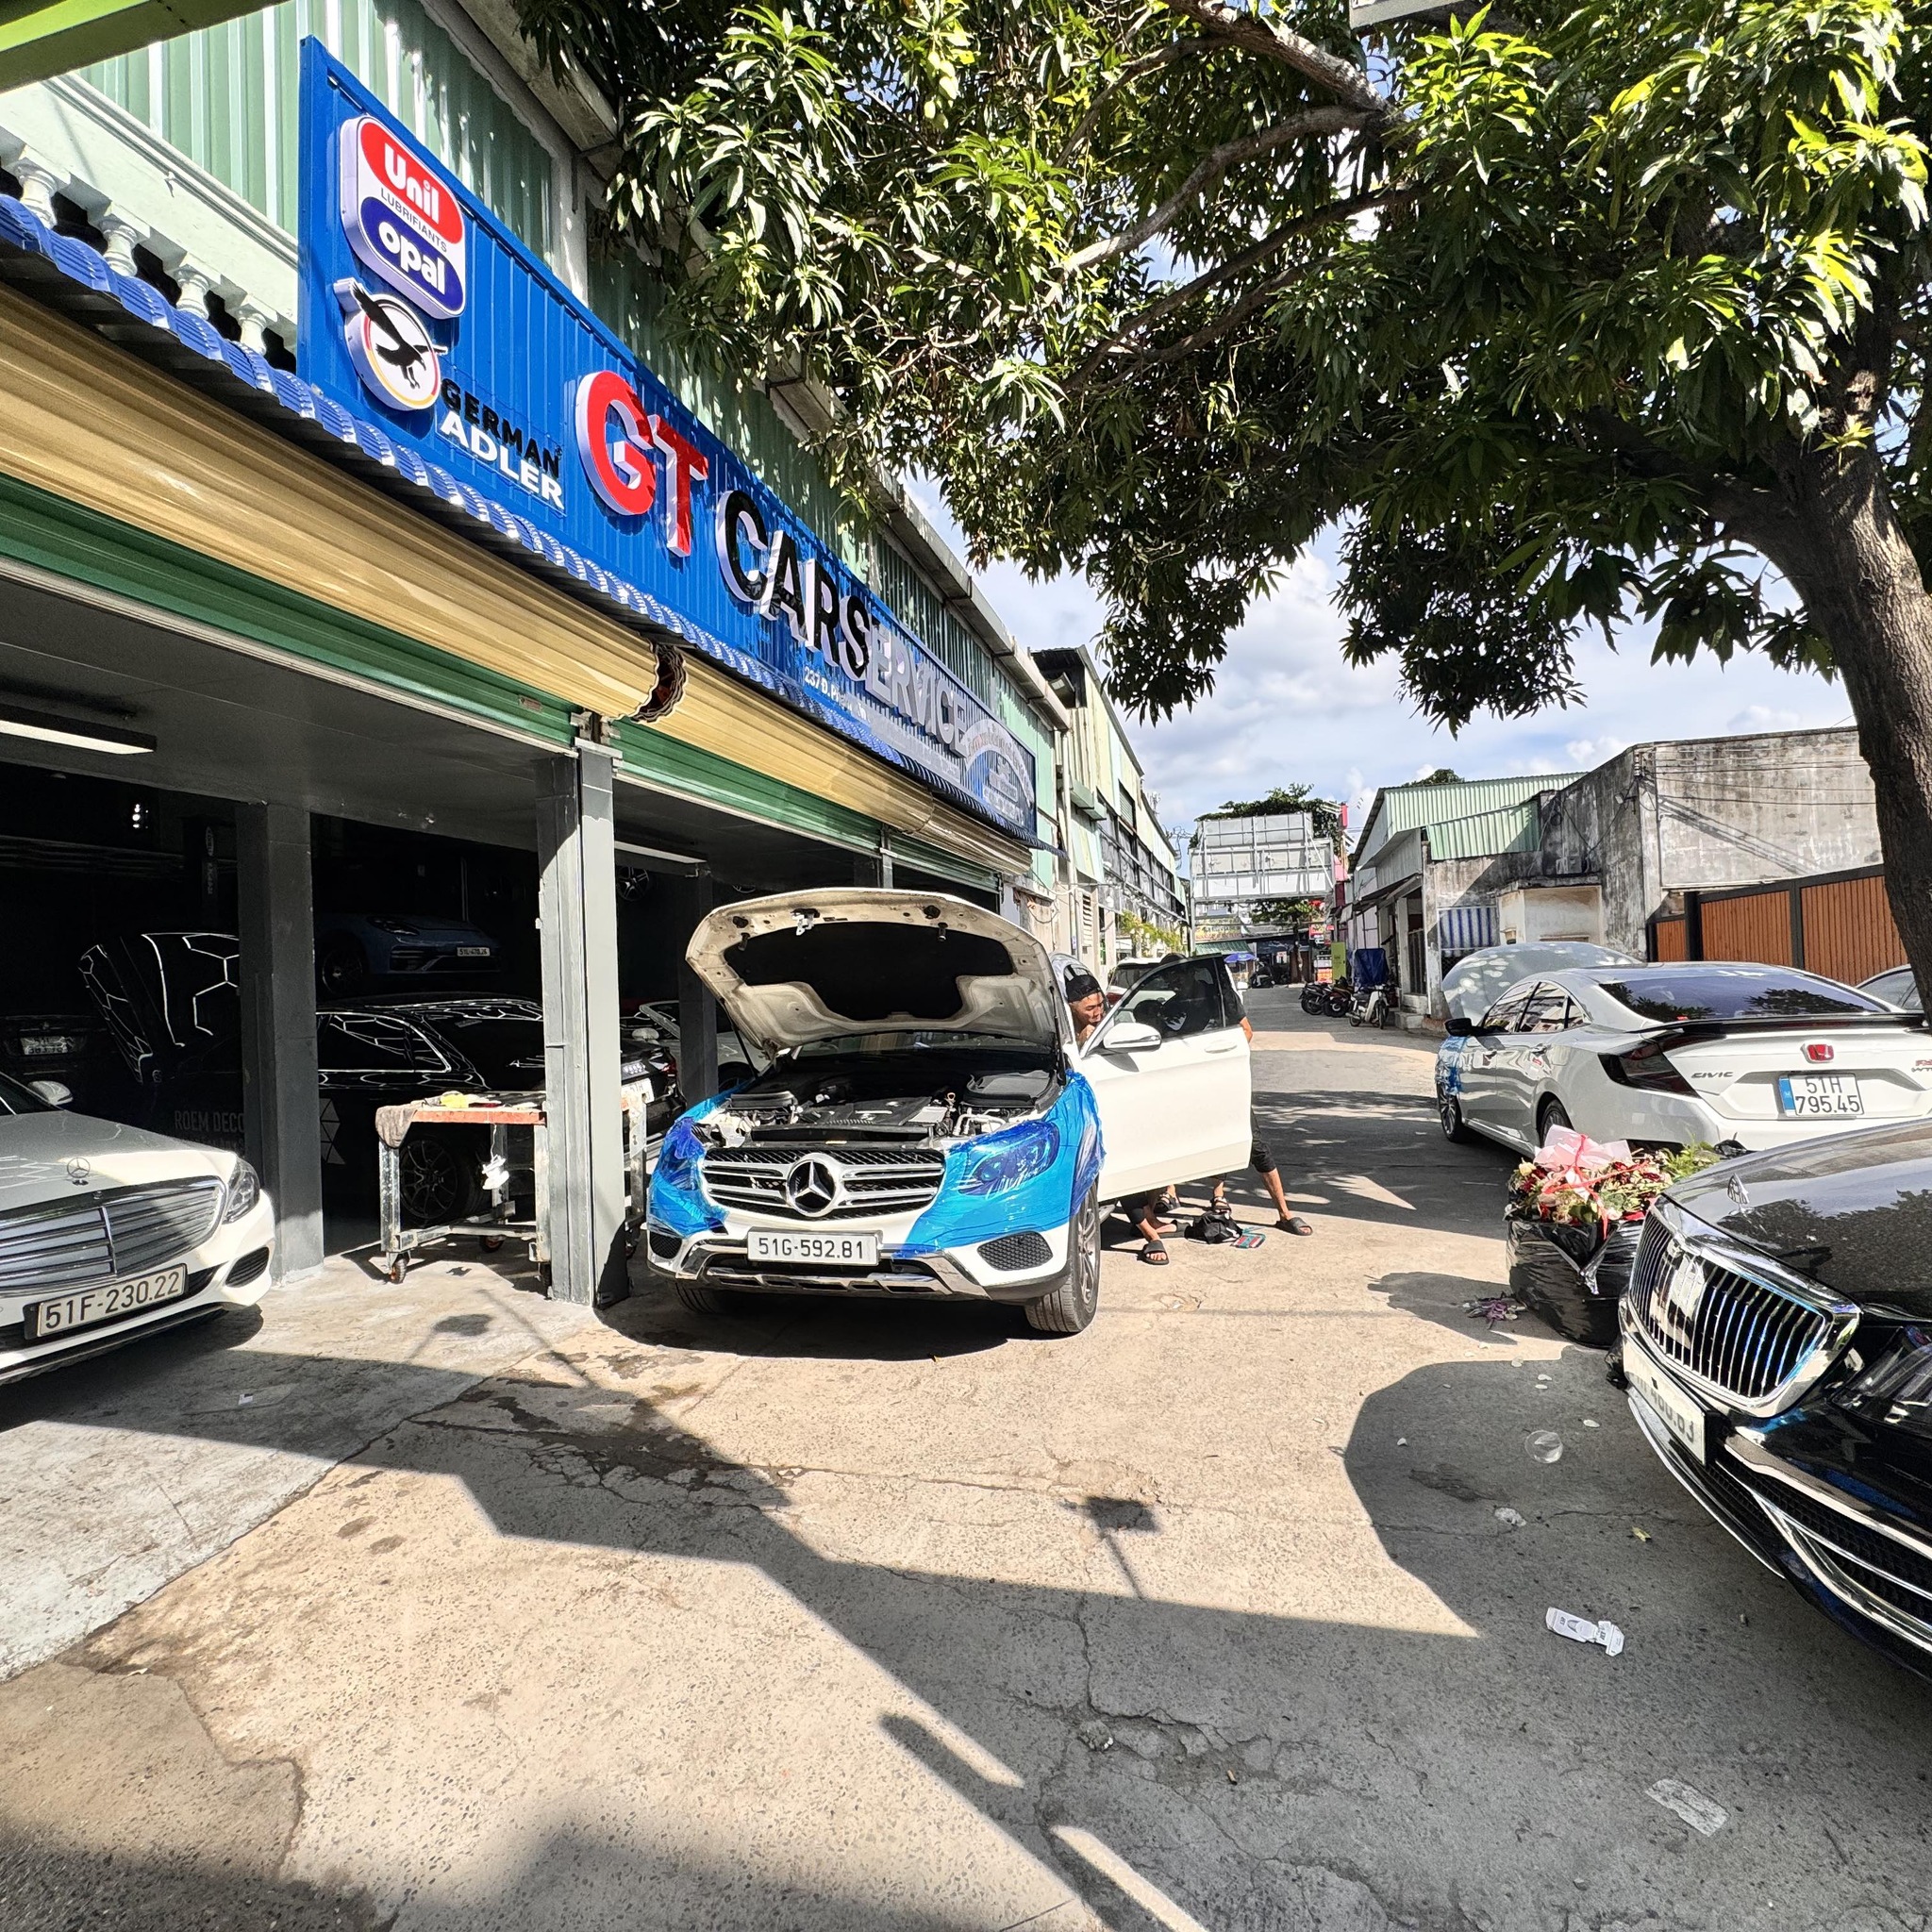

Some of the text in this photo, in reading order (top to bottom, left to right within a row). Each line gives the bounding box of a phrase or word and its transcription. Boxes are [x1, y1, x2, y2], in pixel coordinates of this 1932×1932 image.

[384, 142, 440, 225] Unil
[380, 187, 448, 253] LUBRIFIANTS
[378, 221, 445, 295] opal
[440, 410, 565, 510] ADLER
[441, 377, 559, 478] GERMAN
[575, 370, 709, 558] GT
[1690, 1071, 1734, 1079] CIVIC
[1794, 1094, 1861, 1114] 795.45
[1805, 1076, 1842, 1094] 51H
[758, 1237, 863, 1259] 51G-592.81
[45, 1271, 180, 1329] 51F-230.22
